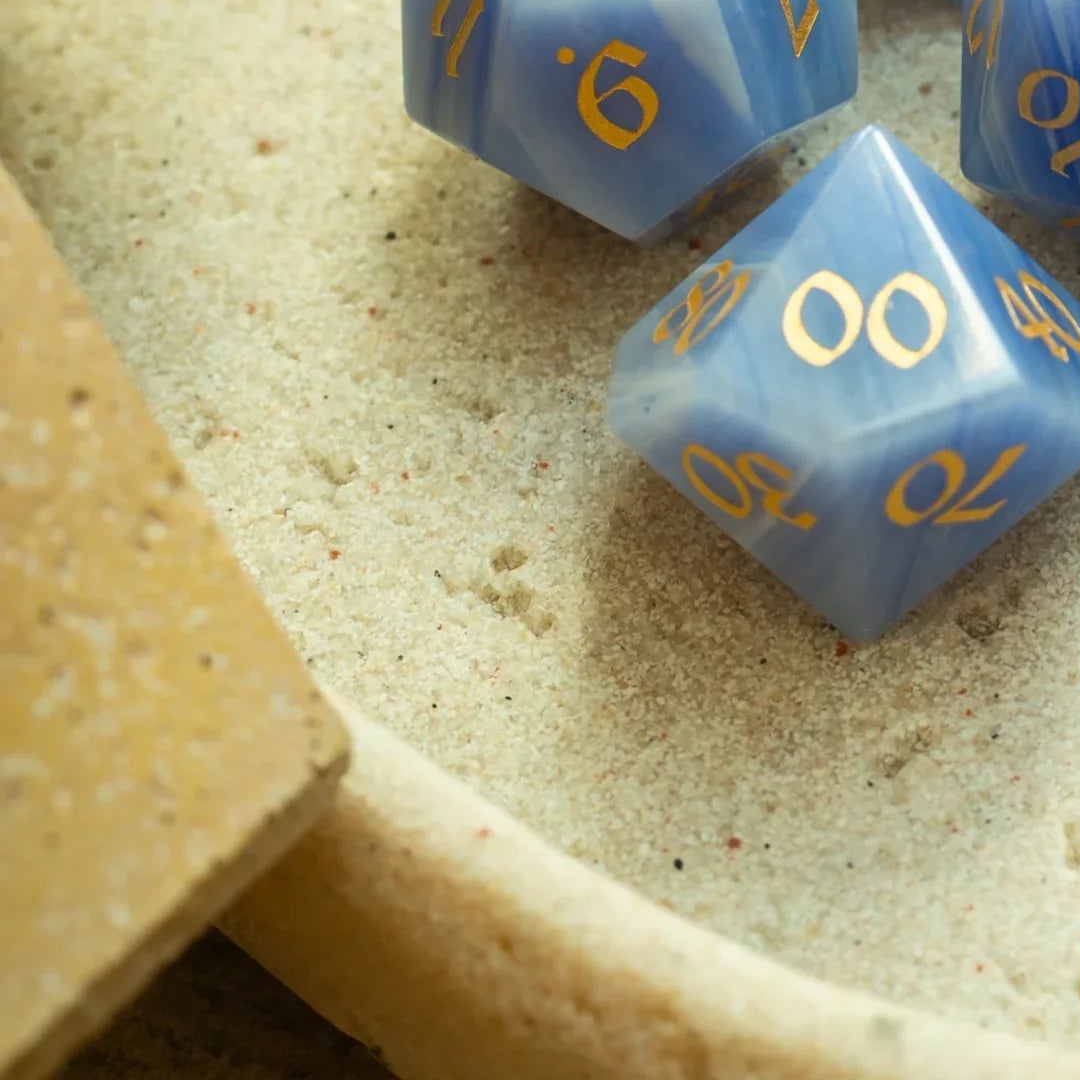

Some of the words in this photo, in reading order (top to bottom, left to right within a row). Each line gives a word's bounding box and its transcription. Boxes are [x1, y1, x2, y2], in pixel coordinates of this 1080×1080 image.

[652, 259, 752, 355] 80
[782, 269, 948, 369] 00
[884, 443, 1028, 527] 70
